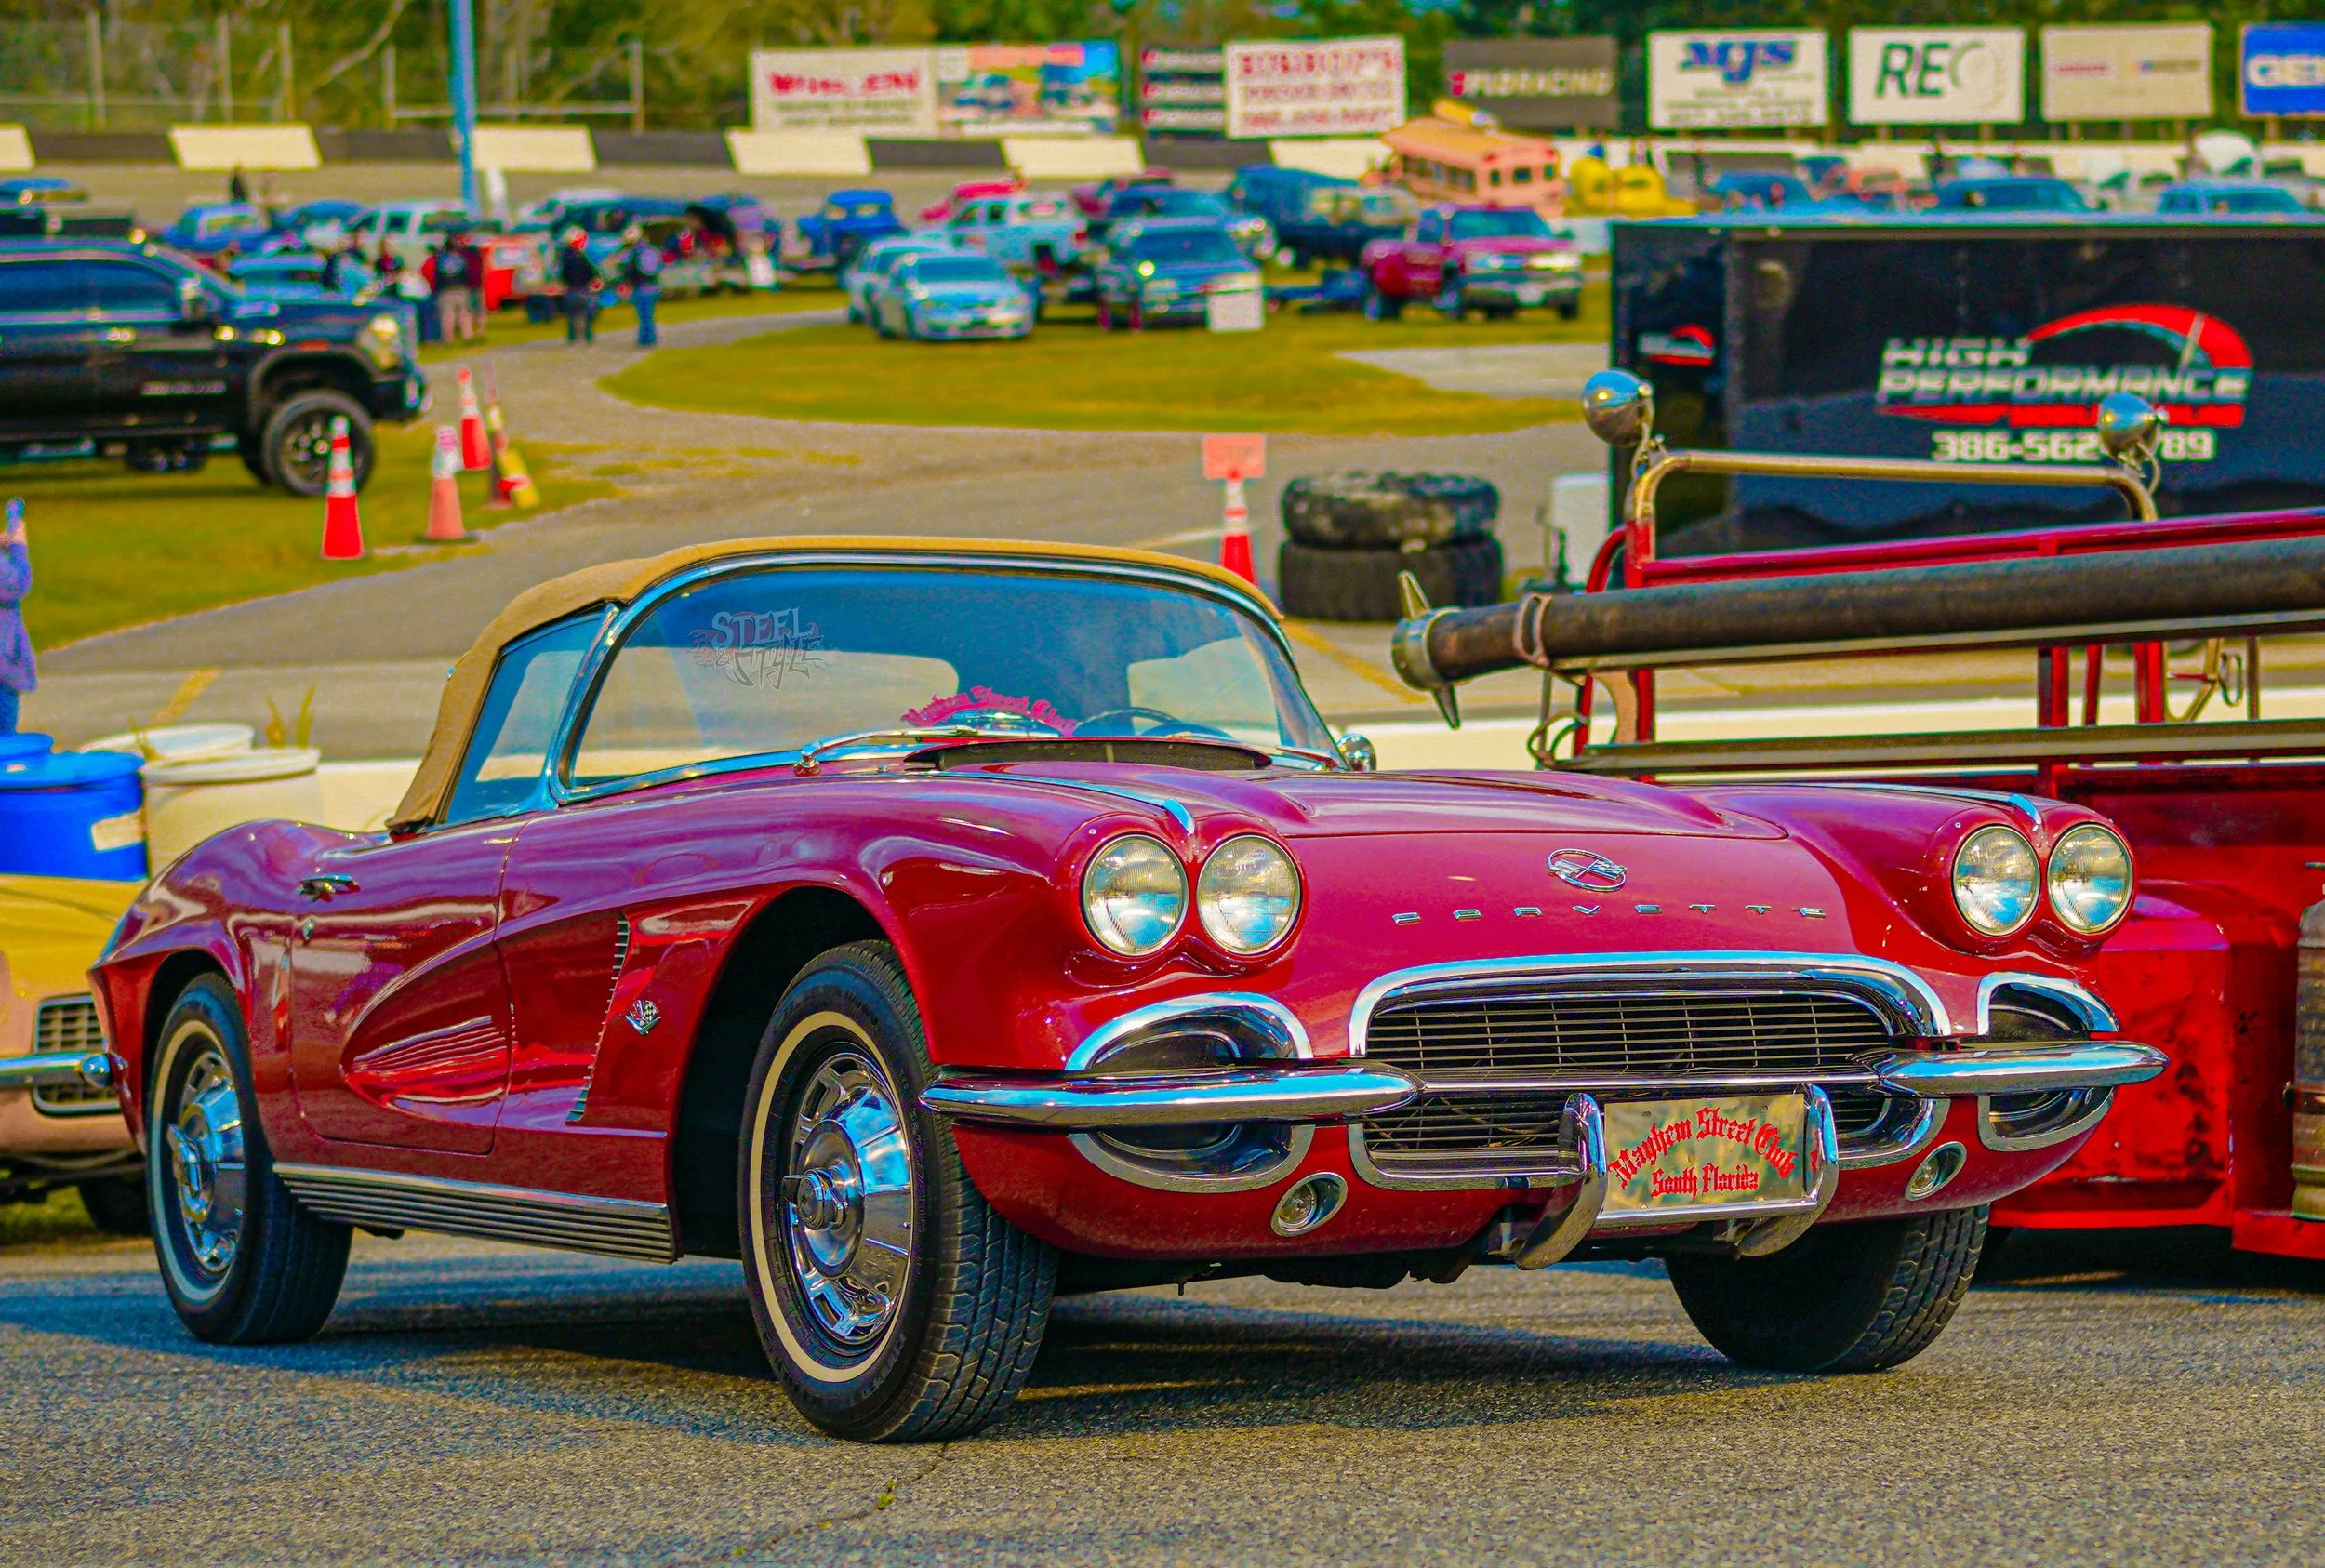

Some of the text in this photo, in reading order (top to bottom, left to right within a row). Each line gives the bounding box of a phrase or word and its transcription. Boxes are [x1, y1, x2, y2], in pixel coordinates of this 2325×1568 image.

[1881, 338, 2033, 367] HIGH
[1876, 367, 2252, 404] PERFORMANCE
[1932, 429, 2218, 462] 386-562-89
[710, 606, 805, 650] STEEL
[713, 645, 731, 668] &
[1608, 1106, 1800, 1190] Mayhem Street Club
[1650, 1163, 1760, 1200] South Florida
